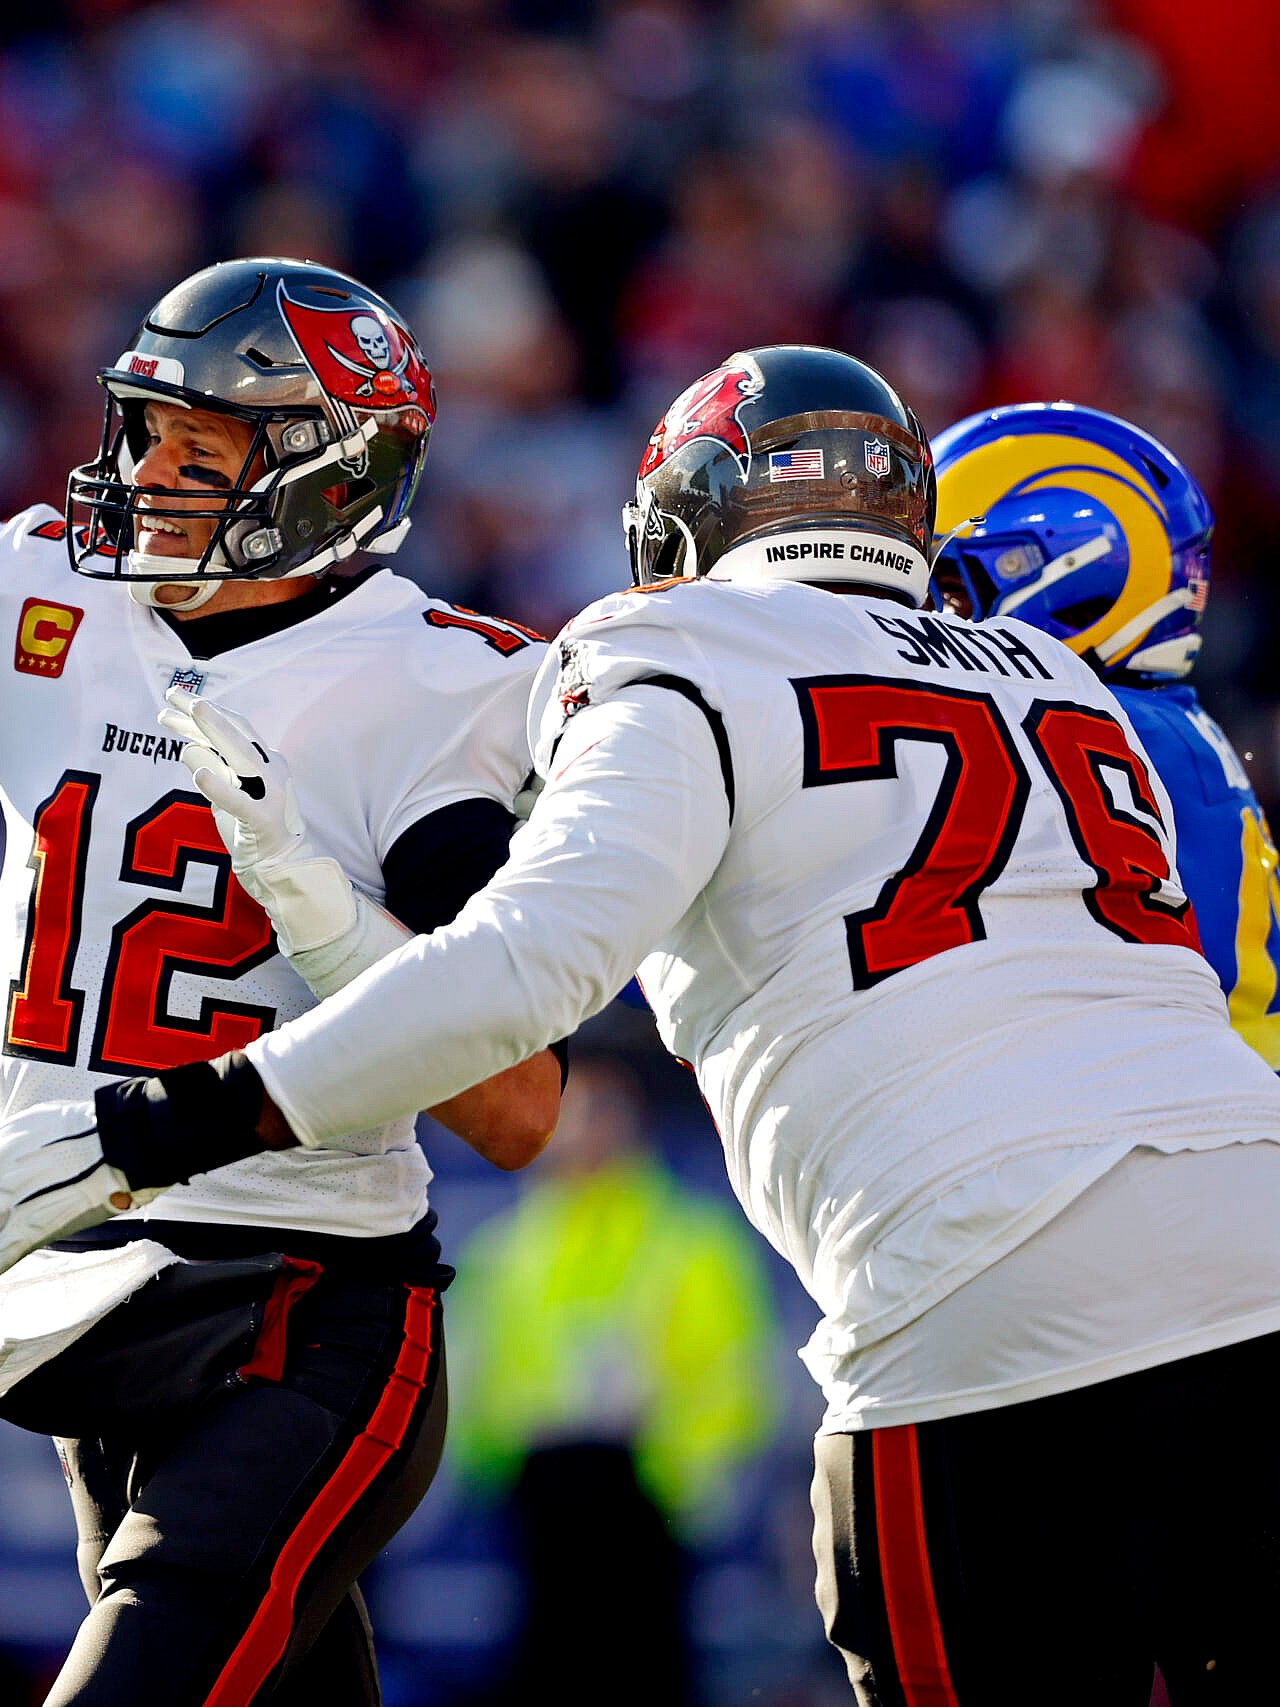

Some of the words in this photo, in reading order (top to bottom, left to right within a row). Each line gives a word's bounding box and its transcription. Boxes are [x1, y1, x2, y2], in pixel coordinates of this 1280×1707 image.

[868, 454, 888, 471] NFL
[765, 543, 845, 563] INSPIRE
[850, 545, 914, 575] CHANGE
[20, 604, 75, 658] C
[864, 609, 1055, 680] SMITH
[102, 722, 189, 766] BUCCAN
[1, 768, 281, 1079] 12
